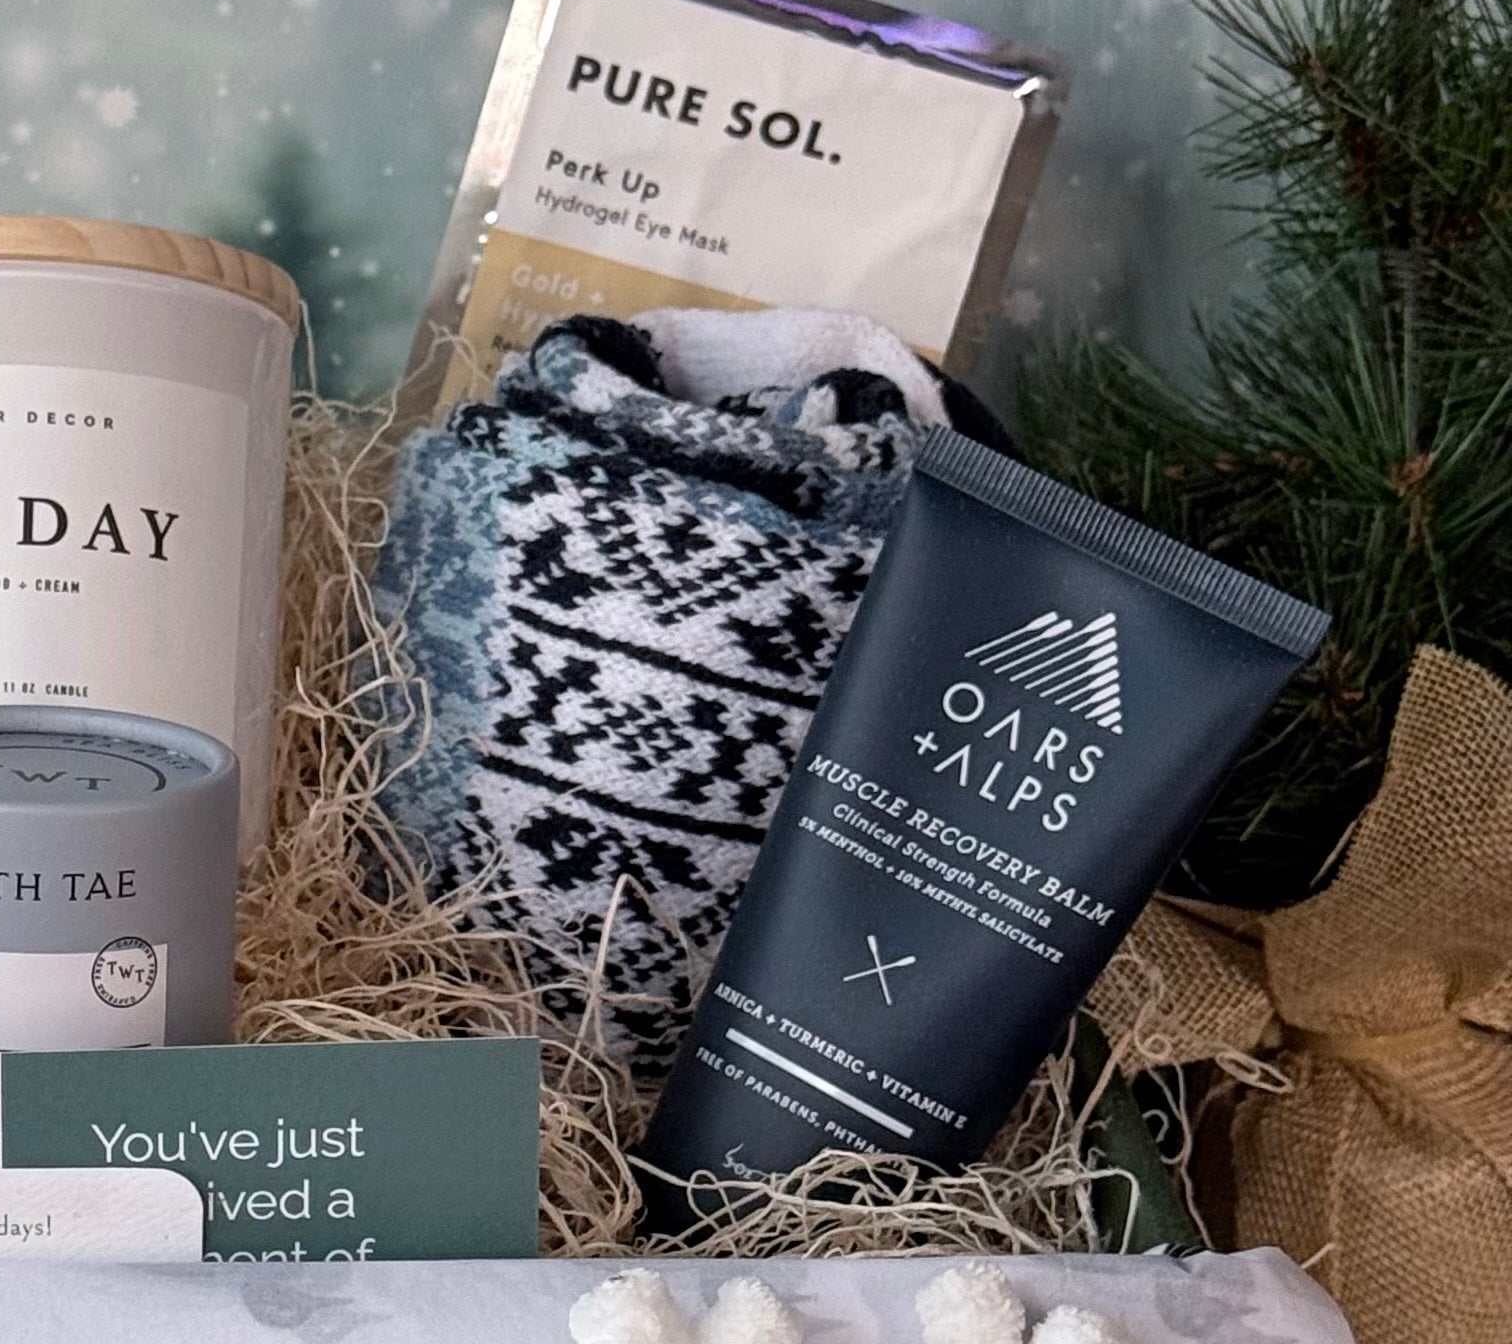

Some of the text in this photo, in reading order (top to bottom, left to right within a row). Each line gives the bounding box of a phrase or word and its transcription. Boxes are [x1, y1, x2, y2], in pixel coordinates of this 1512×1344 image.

[567, 55, 841, 165] PURE SOL.
[545, 149, 660, 203] Perk Up
[535, 186, 729, 256] Hydrogel Eye Mask
[512, 264, 580, 301] Gold
[27, 411, 114, 430] DECOR
[16, 496, 179, 561] DAY
[35, 579, 80, 594] CREAM
[21, 682, 35, 694] OZ
[45, 683, 88, 699] CANDLE
[942, 682, 1105, 784] OARS
[807, 754, 1116, 927] MUSCLE RECOVERY BALM
[832, 803, 1053, 929] Clinical Strength Formula
[62, 869, 137, 901] TAE
[815, 824, 886, 871] MENTHOL
[921, 883, 979, 920] METHYL
[977, 911, 1065, 965] SALICYLATE
[107, 961, 145, 984] TWT
[713, 982, 764, 1020] ARNICA
[778, 1017, 865, 1075] TURMERIC
[881, 1072, 957, 1124] VITAMIN
[954, 1115, 969, 1131] E
[724, 1063, 745, 1081] OF
[744, 1075, 822, 1128] PARABENS,
[90, 1118, 365, 1169] You've just
[207, 1178, 356, 1221] ived a
